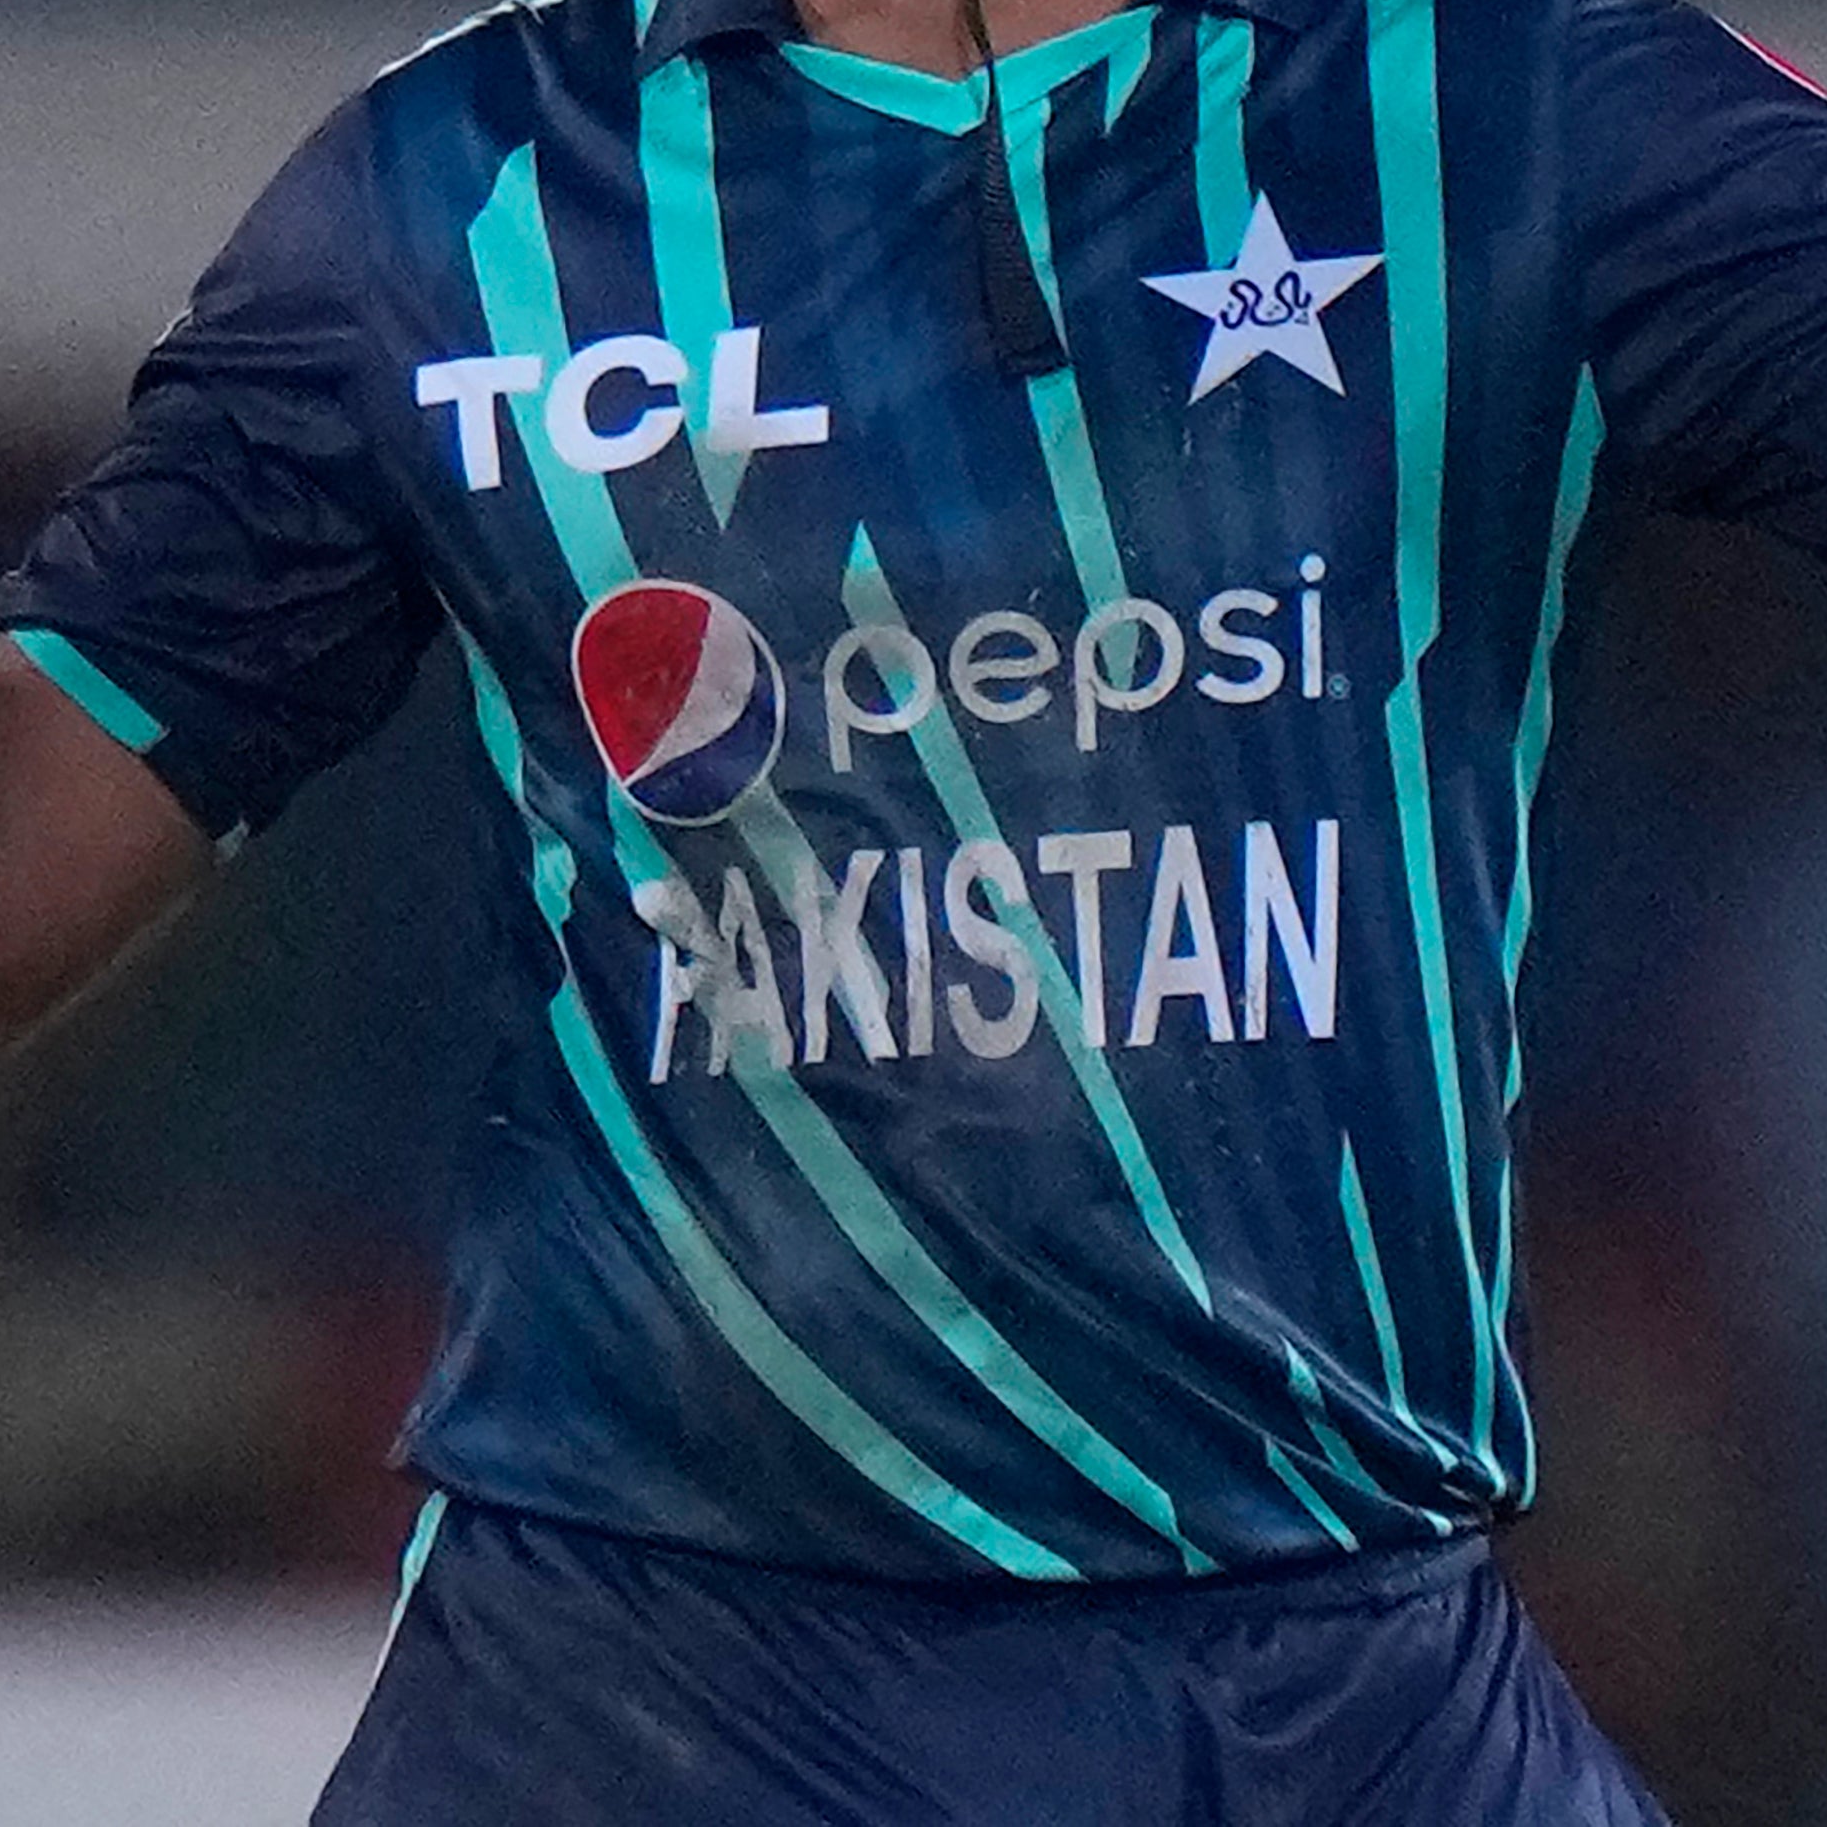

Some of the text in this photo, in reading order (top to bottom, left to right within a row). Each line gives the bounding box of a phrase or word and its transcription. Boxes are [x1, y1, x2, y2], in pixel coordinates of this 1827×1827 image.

[416, 326, 829, 491] TCL
[824, 554, 1326, 773] pepsi
[633, 819, 1339, 1085] PAKISTAN
